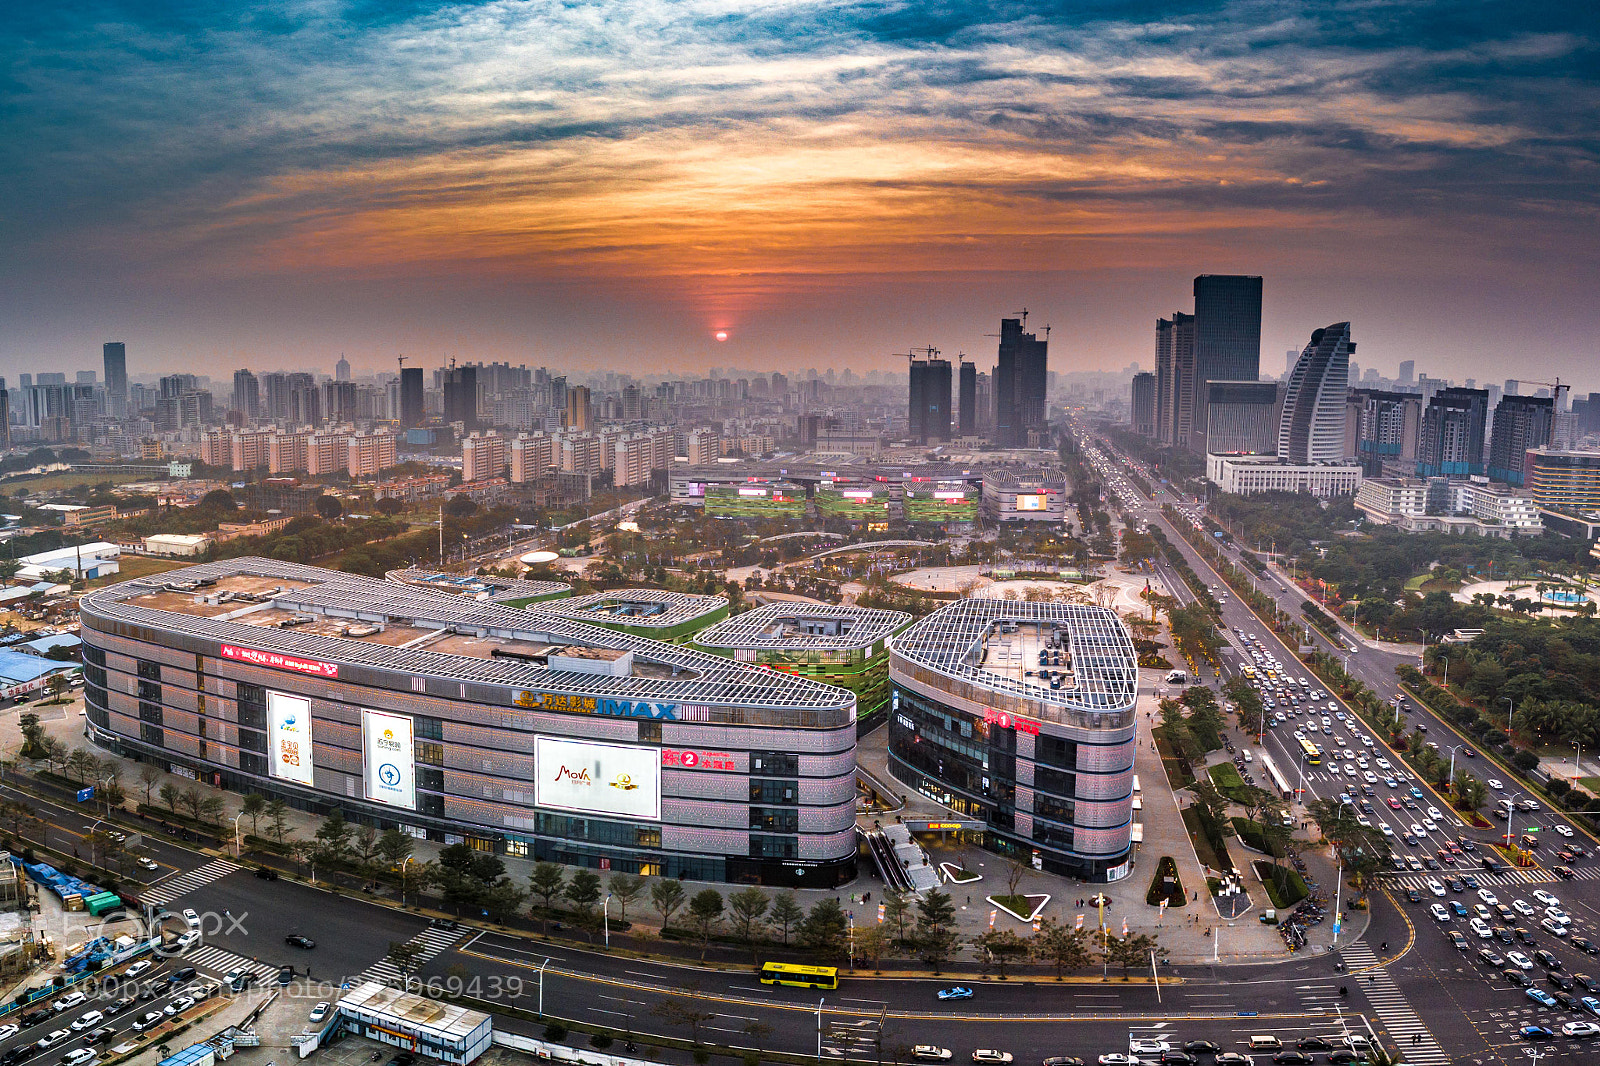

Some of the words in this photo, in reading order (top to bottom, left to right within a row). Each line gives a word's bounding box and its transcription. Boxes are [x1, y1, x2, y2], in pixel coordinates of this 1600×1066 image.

[541, 693, 596, 710] 万达影城
[597, 698, 676, 720] IMAX
